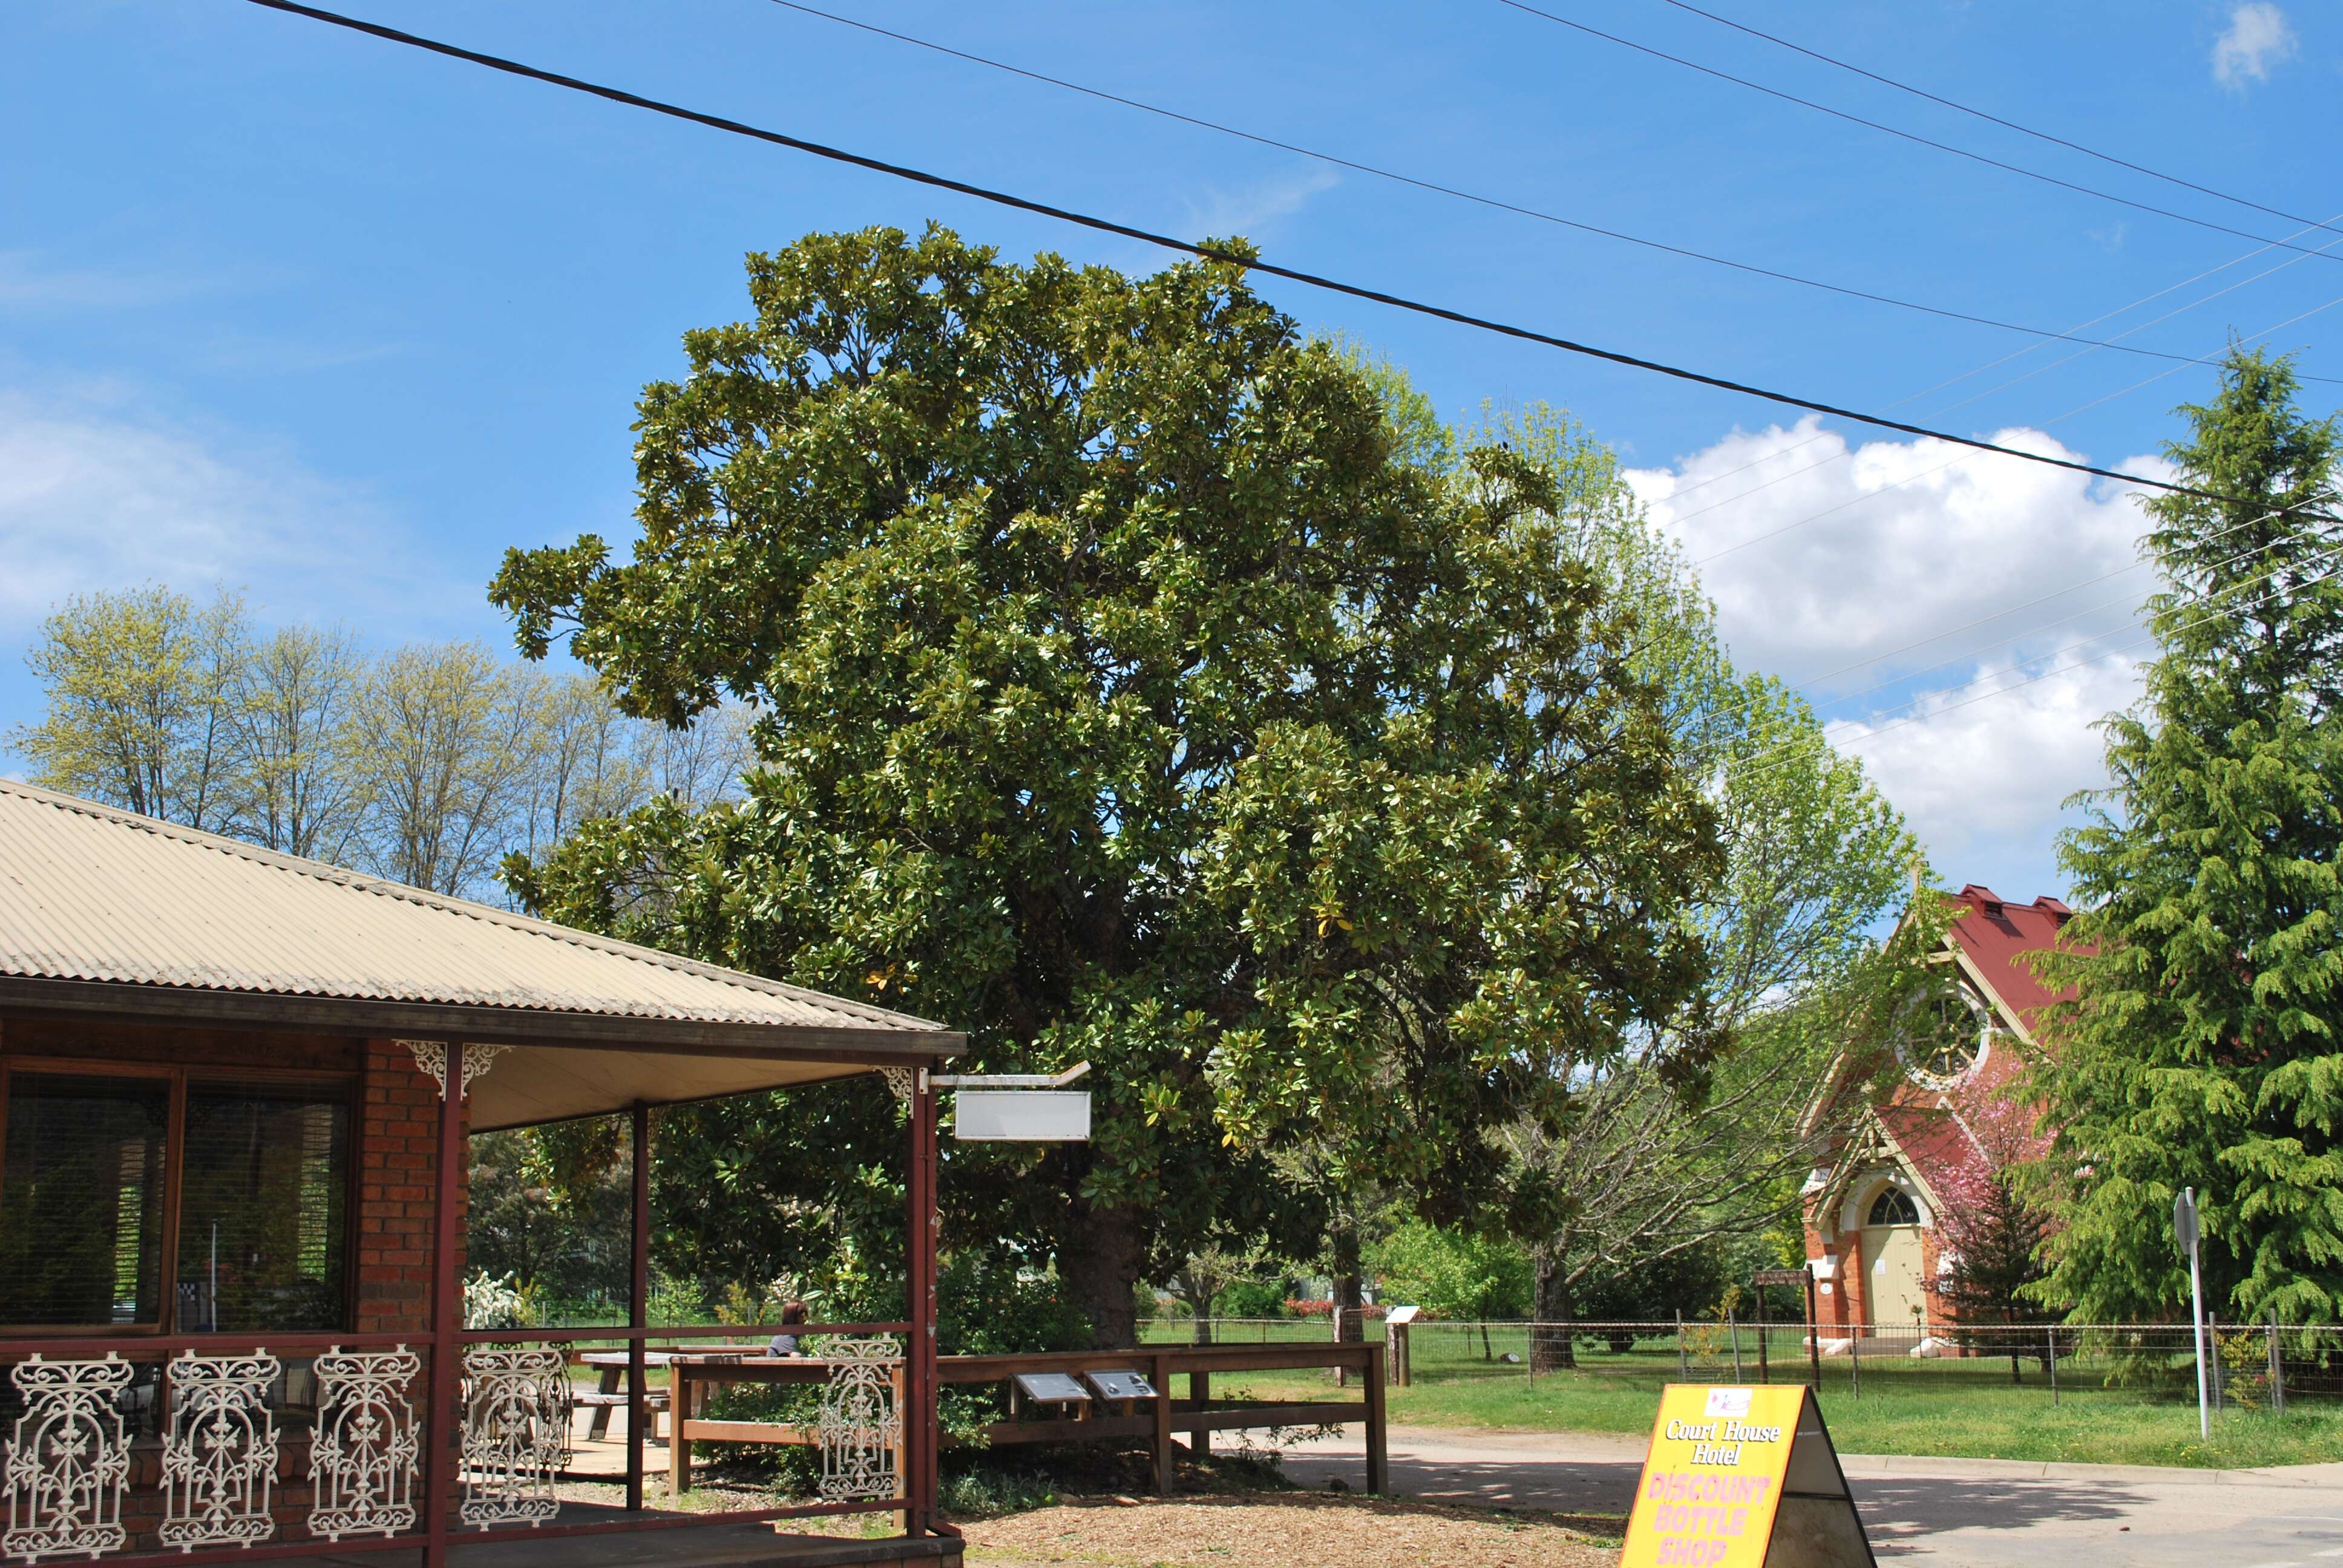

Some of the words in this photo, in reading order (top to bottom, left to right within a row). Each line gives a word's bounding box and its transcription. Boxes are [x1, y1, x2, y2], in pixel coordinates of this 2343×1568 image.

[1666, 1419, 1717, 1440] Court
[1722, 1420, 1781, 1442] House
[1691, 1443, 1742, 1465] Hotel
[1648, 1472, 1772, 1504] DISCOUNT
[1654, 1504, 1748, 1536] BOTTLE
[1657, 1537, 1727, 1567] SHOP
